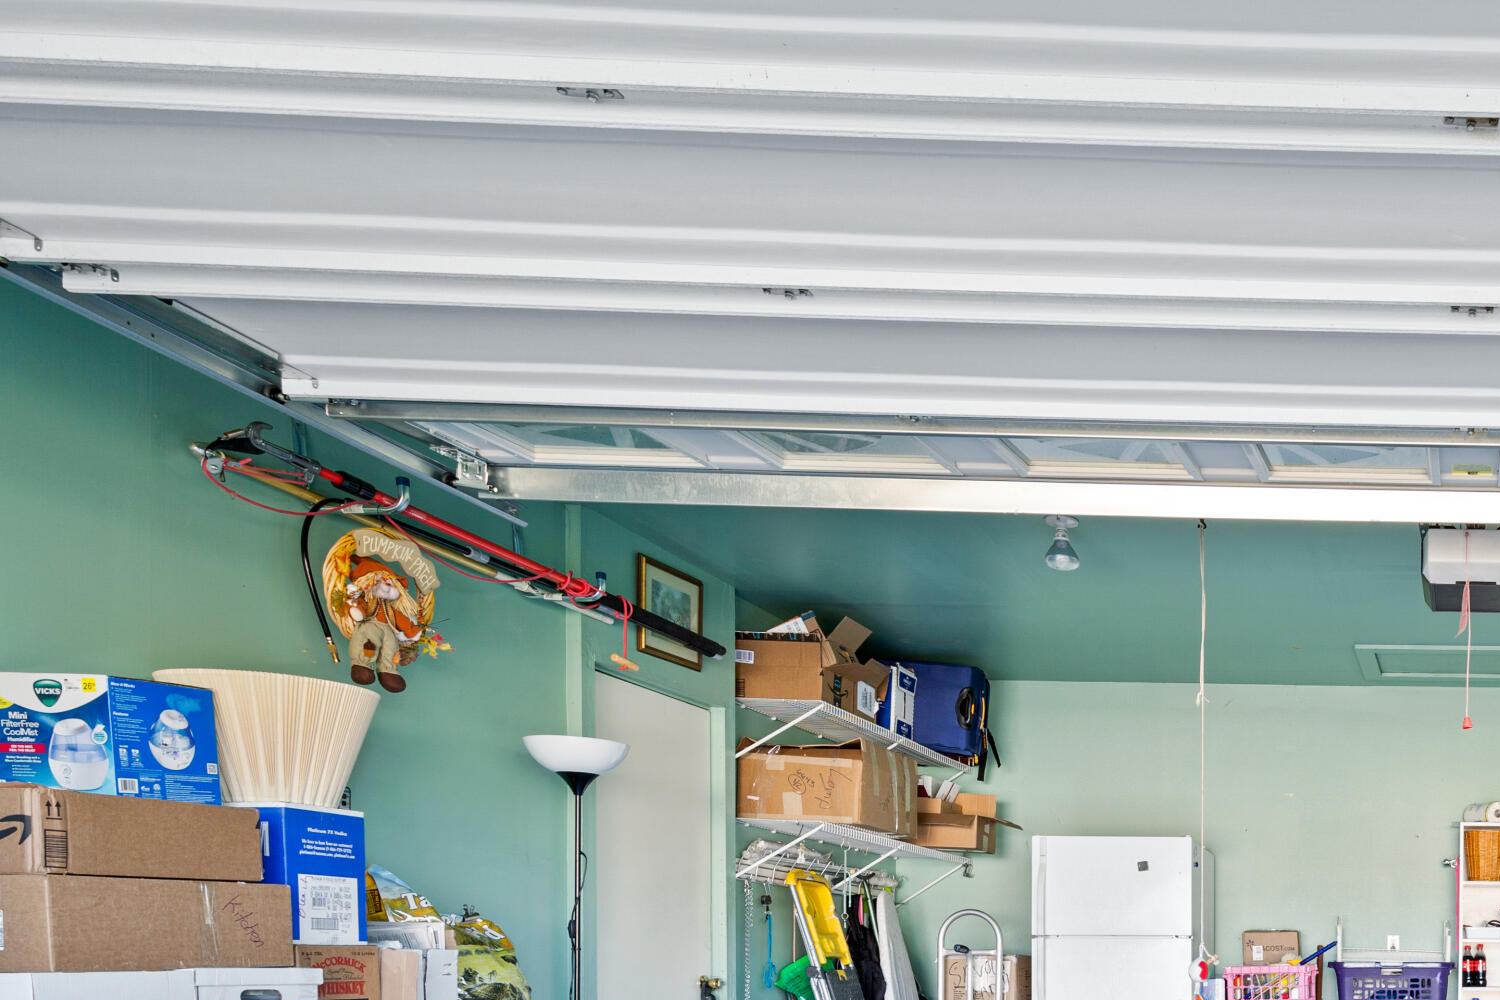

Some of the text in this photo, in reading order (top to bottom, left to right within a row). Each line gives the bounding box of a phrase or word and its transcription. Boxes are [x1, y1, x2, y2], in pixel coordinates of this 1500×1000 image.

[362, 535, 436, 591] PUMPKIN PATCH
[34, 687, 61, 695] VICKS
[8, 711, 28, 720] Mini
[3, 727, 39, 736] CoolMist
[222, 894, 265, 948] Kitchen
